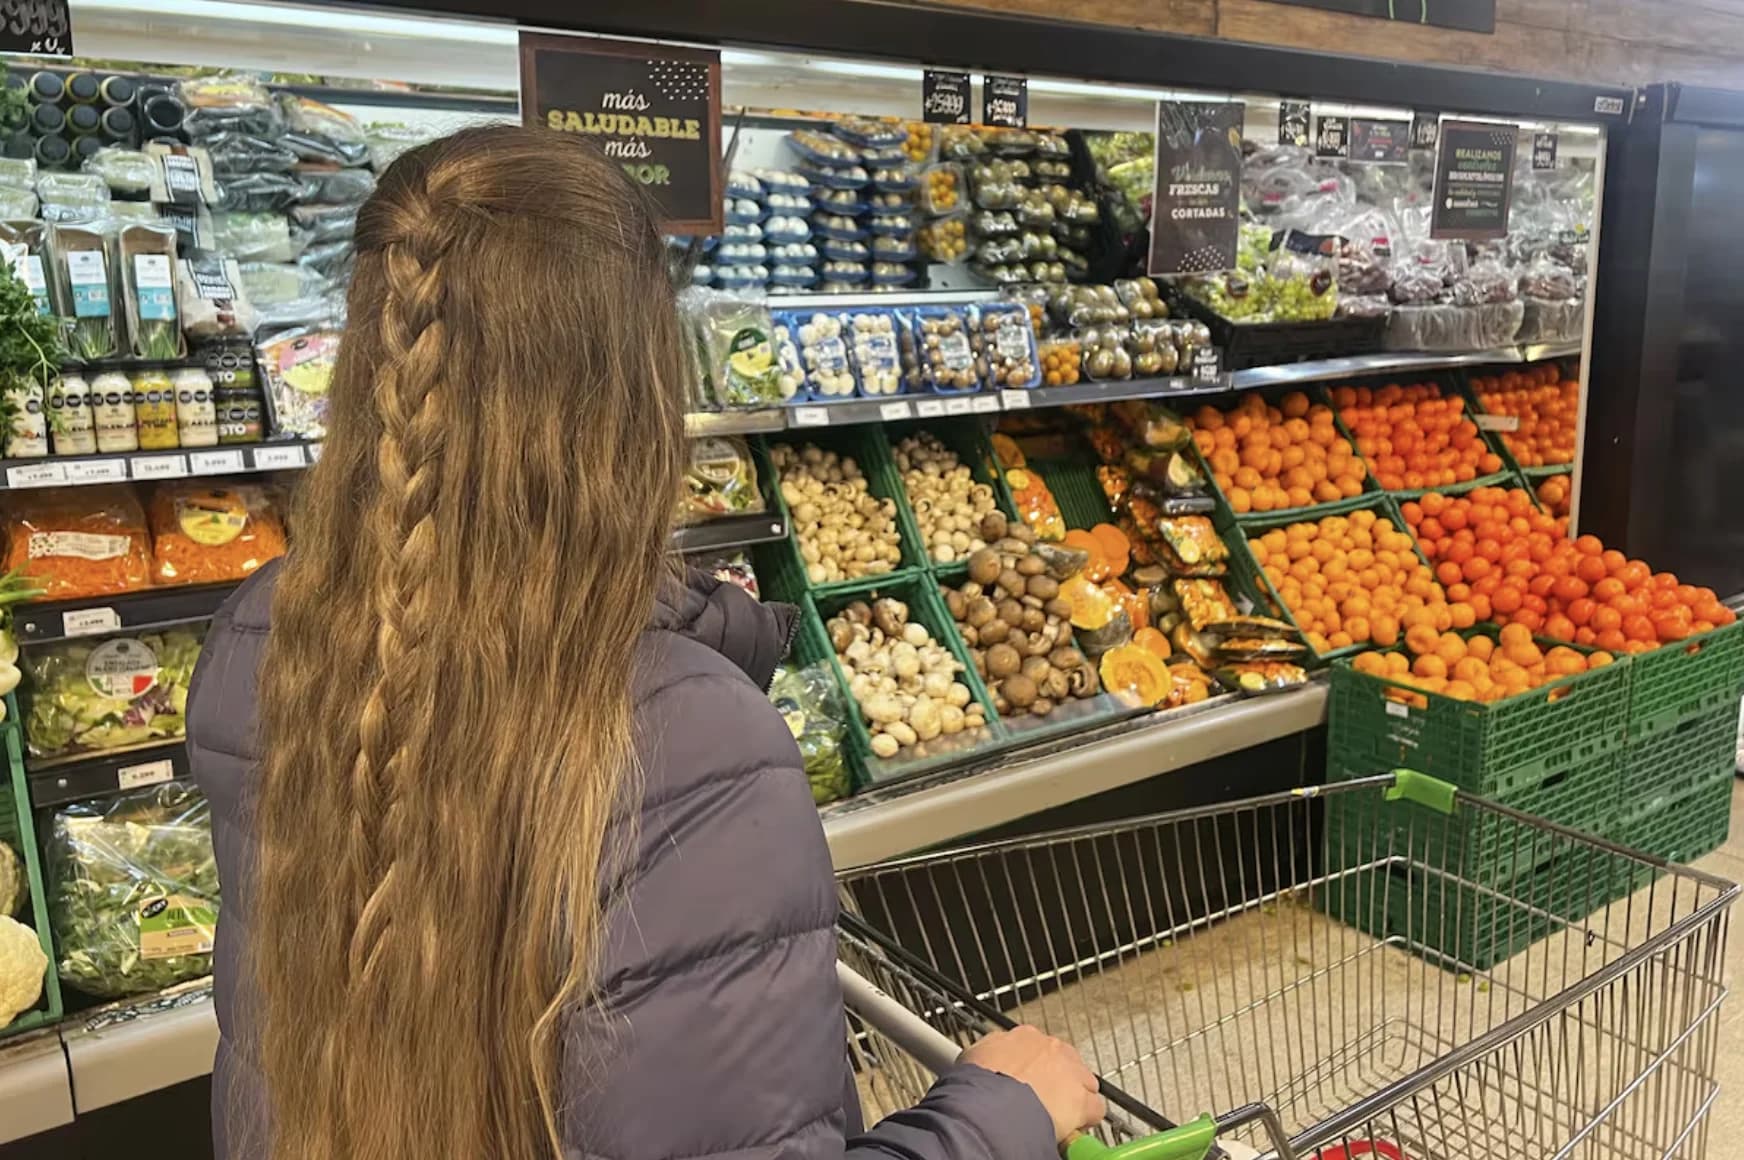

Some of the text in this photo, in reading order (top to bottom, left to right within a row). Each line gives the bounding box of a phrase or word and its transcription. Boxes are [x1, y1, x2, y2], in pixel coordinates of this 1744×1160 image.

[602, 89, 650, 109] más
[548, 110, 700, 139] SALUDABLE
[605, 137, 651, 158] más
[1169, 183, 1219, 196] FRESCAS
[1171, 206, 1225, 220] CORTADAS
